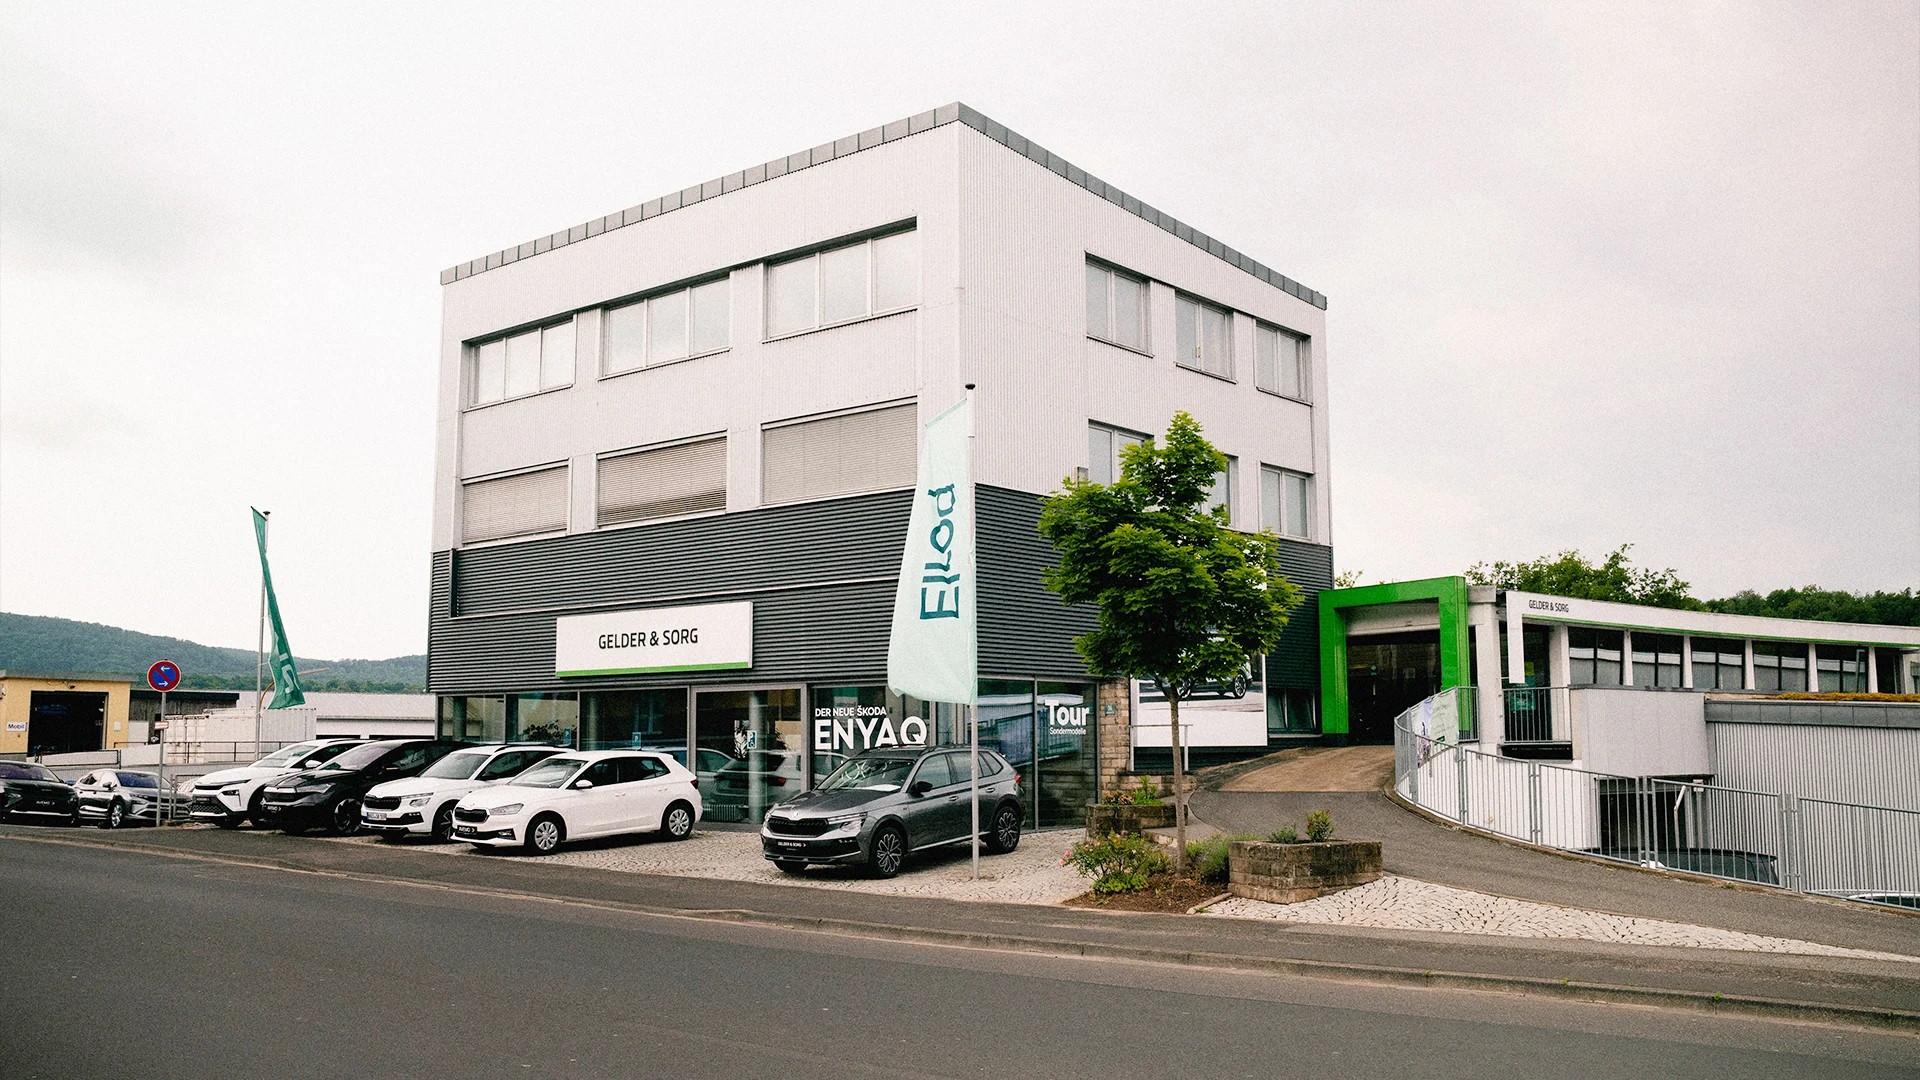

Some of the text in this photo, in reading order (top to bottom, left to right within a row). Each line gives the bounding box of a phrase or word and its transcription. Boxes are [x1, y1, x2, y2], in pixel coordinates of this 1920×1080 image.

[1528, 599, 1569, 613] GELDER & SORG
[598, 628, 698, 650] GELDER & SORG
[814, 704, 887, 717] DER NEUE ŠKODA
[1044, 699, 1090, 726] Tour
[814, 715, 928, 750] ENYAQ
[1049, 726, 1087, 735] Sondermodelle
